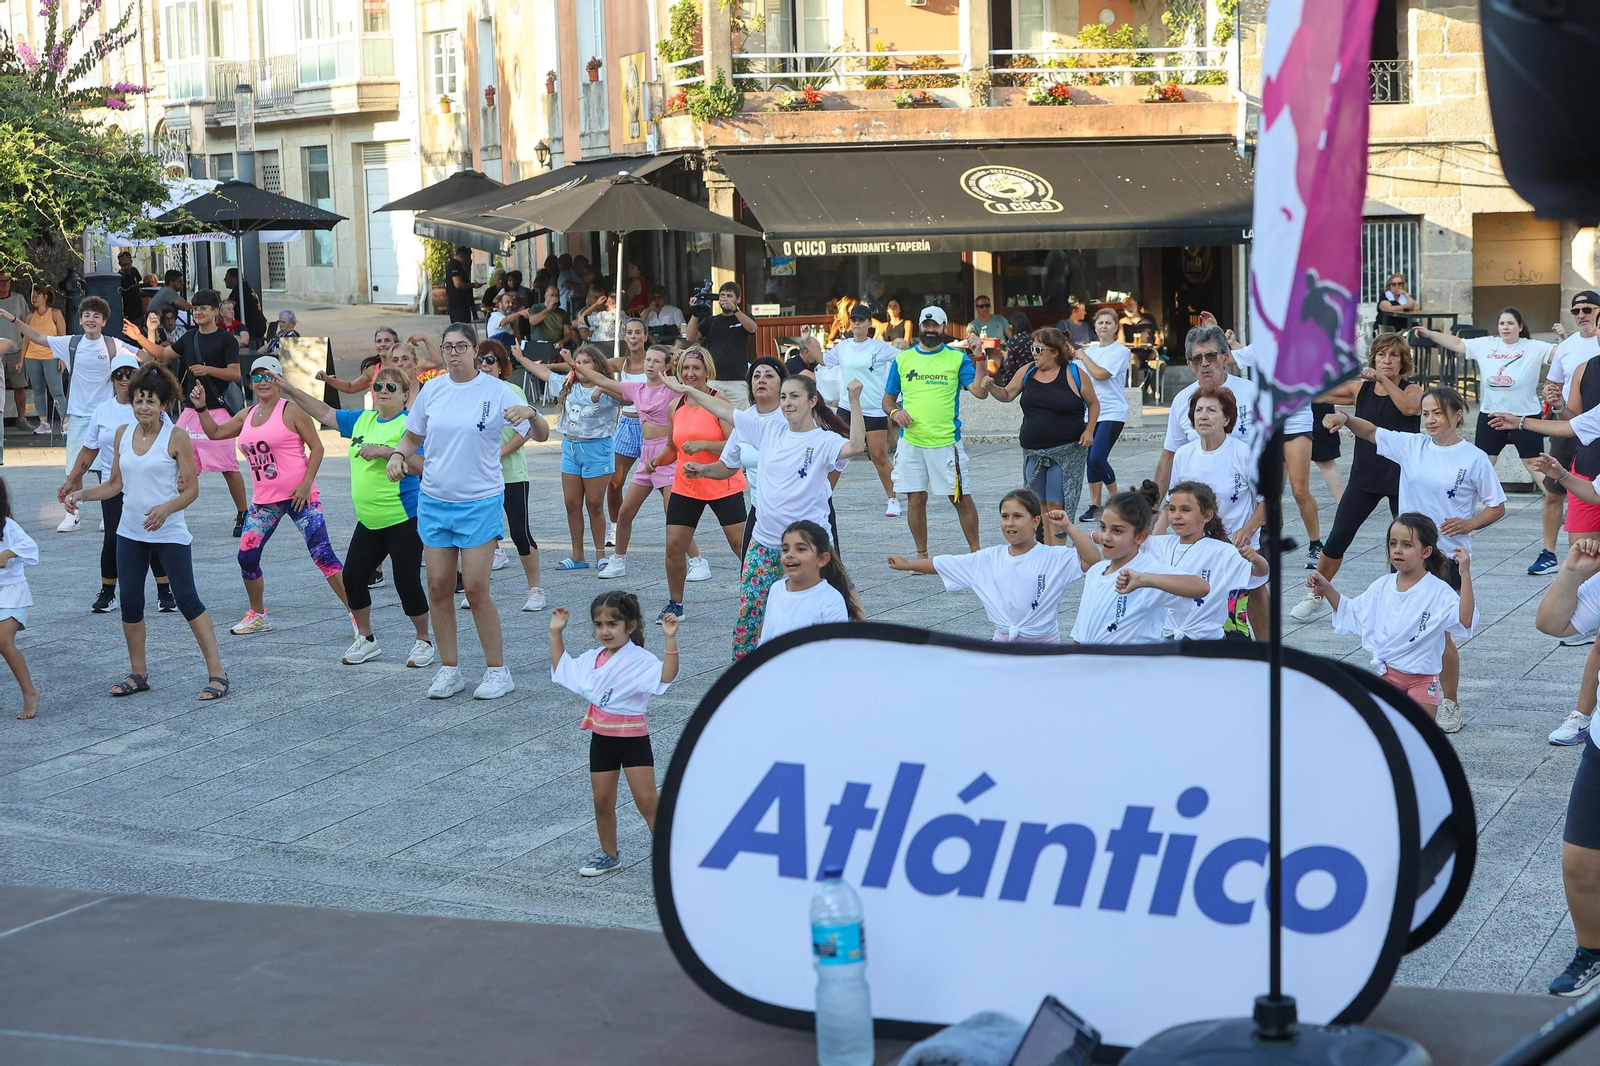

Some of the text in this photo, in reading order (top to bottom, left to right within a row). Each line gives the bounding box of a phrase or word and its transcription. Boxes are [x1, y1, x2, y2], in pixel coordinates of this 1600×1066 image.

[995, 201, 1053, 212] O CUCO
[783, 238, 931, 256] O CUCO RESTAURANTE TAPERÍA
[241, 440, 270, 456] NO
[248, 453, 275, 466] LIMI
[251, 463, 278, 481] TS
[1454, 468, 1463, 491] DEPORTE
[698, 761, 1368, 935] Atlántico
